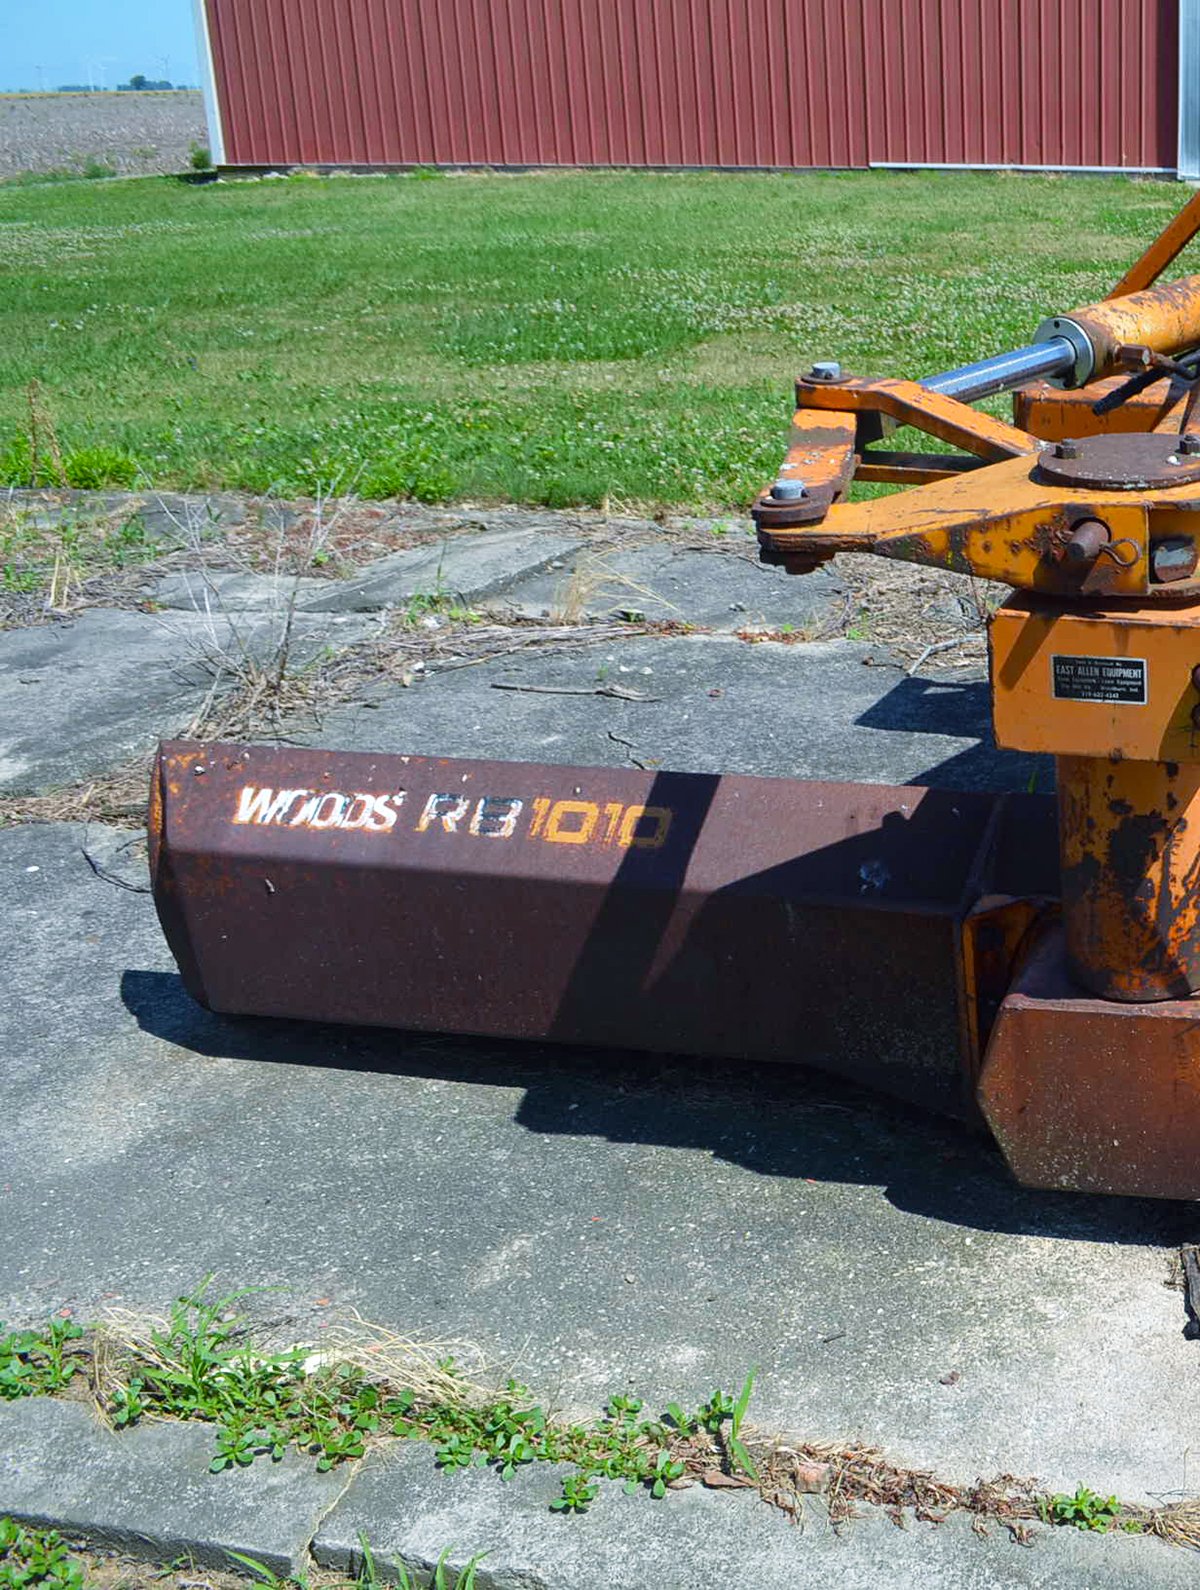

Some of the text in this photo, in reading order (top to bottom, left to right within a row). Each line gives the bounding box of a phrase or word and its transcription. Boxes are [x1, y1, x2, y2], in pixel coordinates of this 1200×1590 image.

[1056, 665, 1142, 679] EAST ALLEN EQUIPMENT
[234, 786, 400, 833] WOODS
